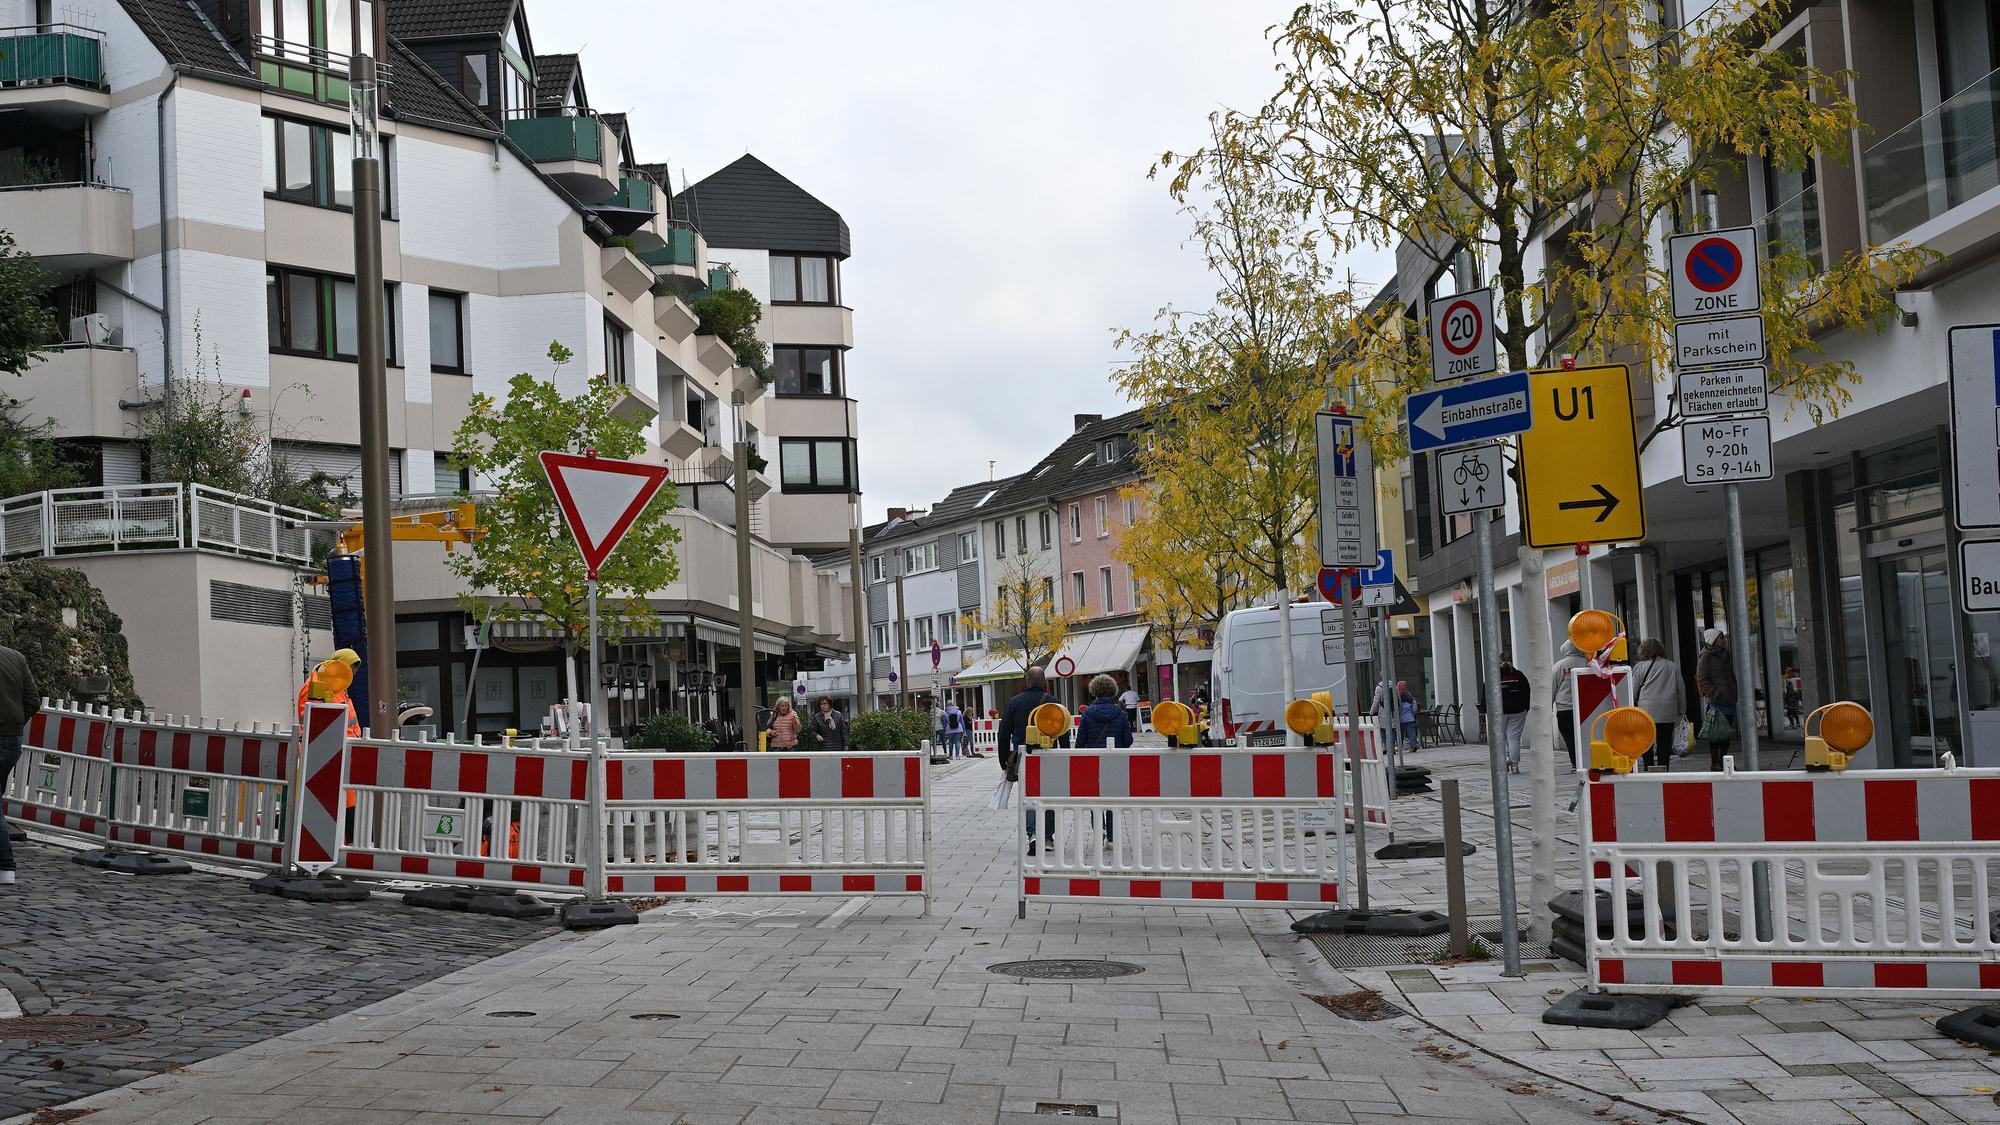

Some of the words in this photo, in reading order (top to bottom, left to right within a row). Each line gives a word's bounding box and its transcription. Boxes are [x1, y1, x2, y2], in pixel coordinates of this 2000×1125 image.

[1694, 294, 1738, 311] ZONE
[1450, 314, 1474, 341] 20
[1708, 328, 1730, 341] mit
[1683, 341, 1757, 357] Parkschein
[1448, 356, 1480, 374] ZONE
[1700, 375, 1731, 386] Parken
[1735, 373, 1744, 383] in
[1683, 385, 1763, 402] gekennzeichneten
[1441, 397, 1523, 424] Einbahnstraße
[1552, 385, 1594, 421] U1
[1688, 400, 1723, 412] Flächen
[1726, 397, 1759, 409] erlaubt
[1702, 425, 1749, 440] Mo-Fr
[1706, 443, 1748, 458] 9-20h
[1696, 464, 1714, 477] Sa
[1721, 460, 1761, 475] 9-14h
